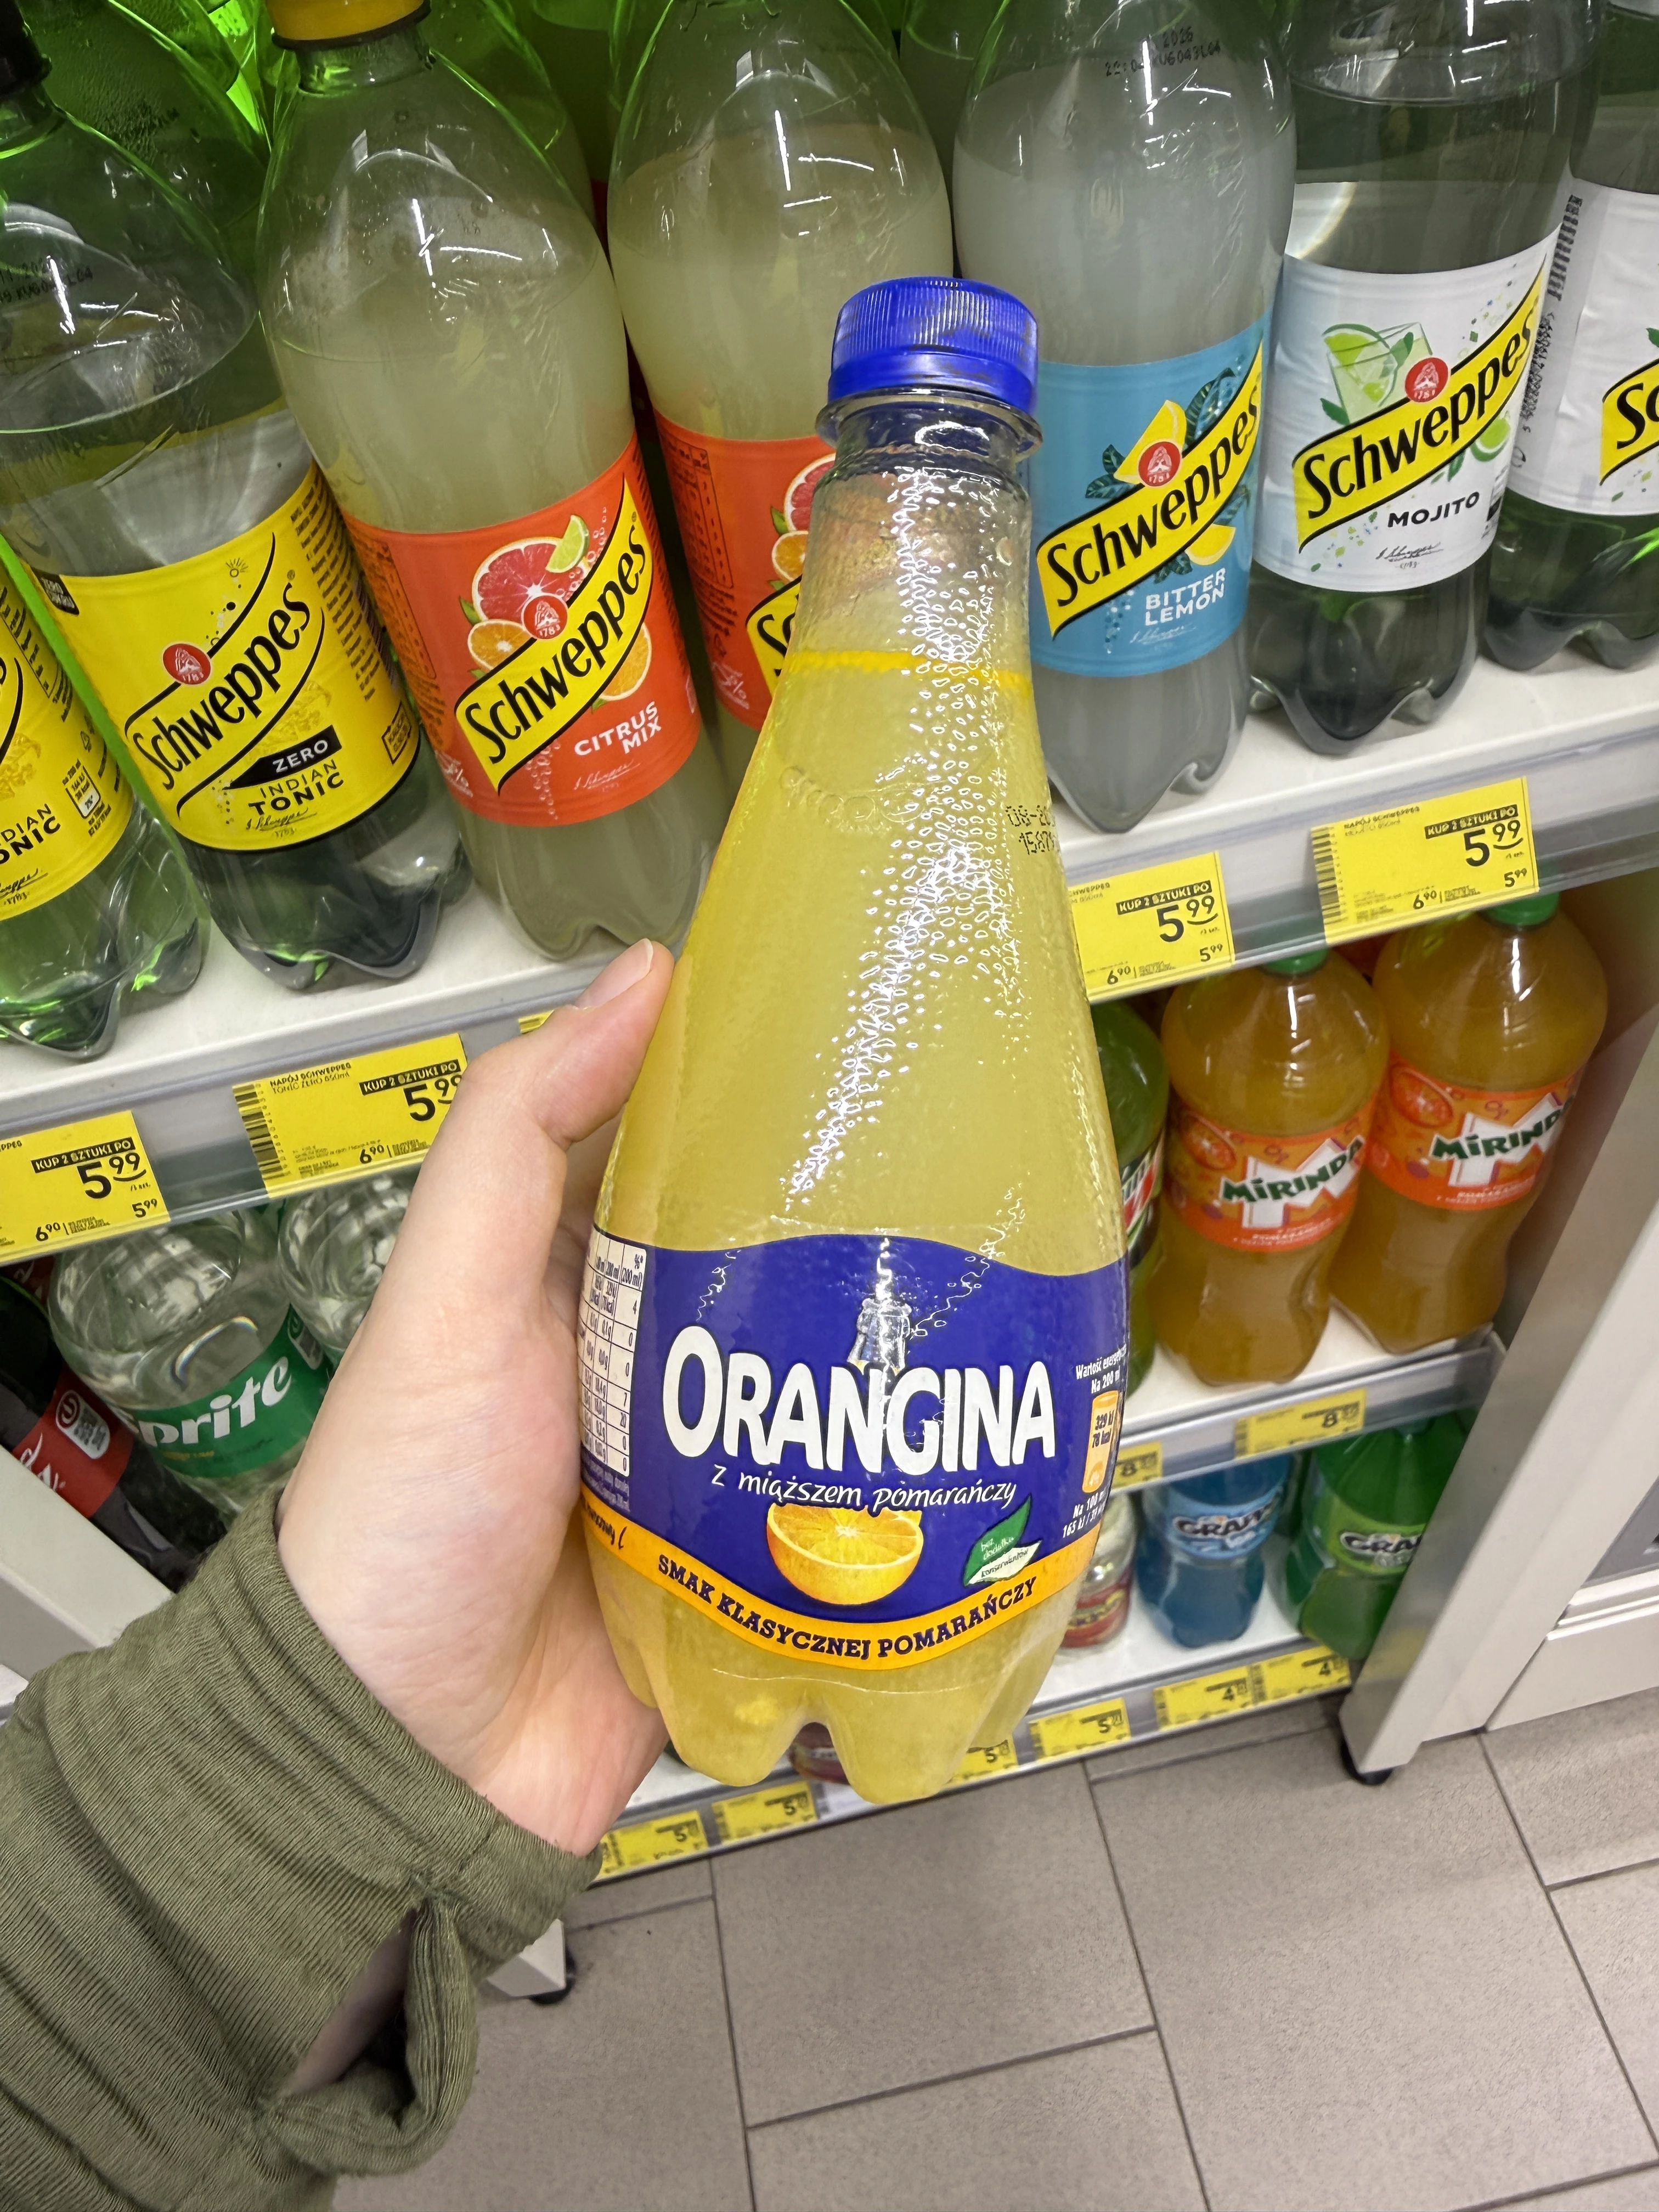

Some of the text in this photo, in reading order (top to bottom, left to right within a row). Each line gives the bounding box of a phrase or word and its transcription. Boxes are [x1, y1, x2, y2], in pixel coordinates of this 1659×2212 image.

[1304, 296, 1538, 518] Schweppes
[1047, 386, 1260, 607] Schweppes
[1387, 491, 1480, 528] MOJITO
[1145, 583, 1224, 626] LEMON
[1146, 567, 1226, 610] BITTER
[466, 524, 646, 765] Schweppes
[539, 624, 561, 638] 1783
[132, 582, 311, 790] Schweppes
[574, 701, 658, 756] CITRUS
[622, 716, 662, 754] MIX
[273, 740, 328, 773] ZERO
[248, 772, 344, 816] TONIC
[259, 759, 337, 798] INDIAN
[1427, 823, 1449, 836] KUP
[1499, 806, 1516, 819] PO
[1119, 882, 1210, 912] KUP 2 SZTUKI PO
[363, 1062, 457, 1092] KUP 2 SZTUKI PO
[35, 1140, 132, 1171] KUP 2 SZTUKI PO
[663, 1324, 1056, 1475] ORANGINA
[738, 1470, 862, 1506] miąższem
[873, 1479, 1017, 1510] pomarańczy
[658, 1554, 716, 1603] SMAK
[716, 1594, 870, 1660] KLASYCZNEJ
[877, 1576, 1037, 1658] POMARAŃCZY
